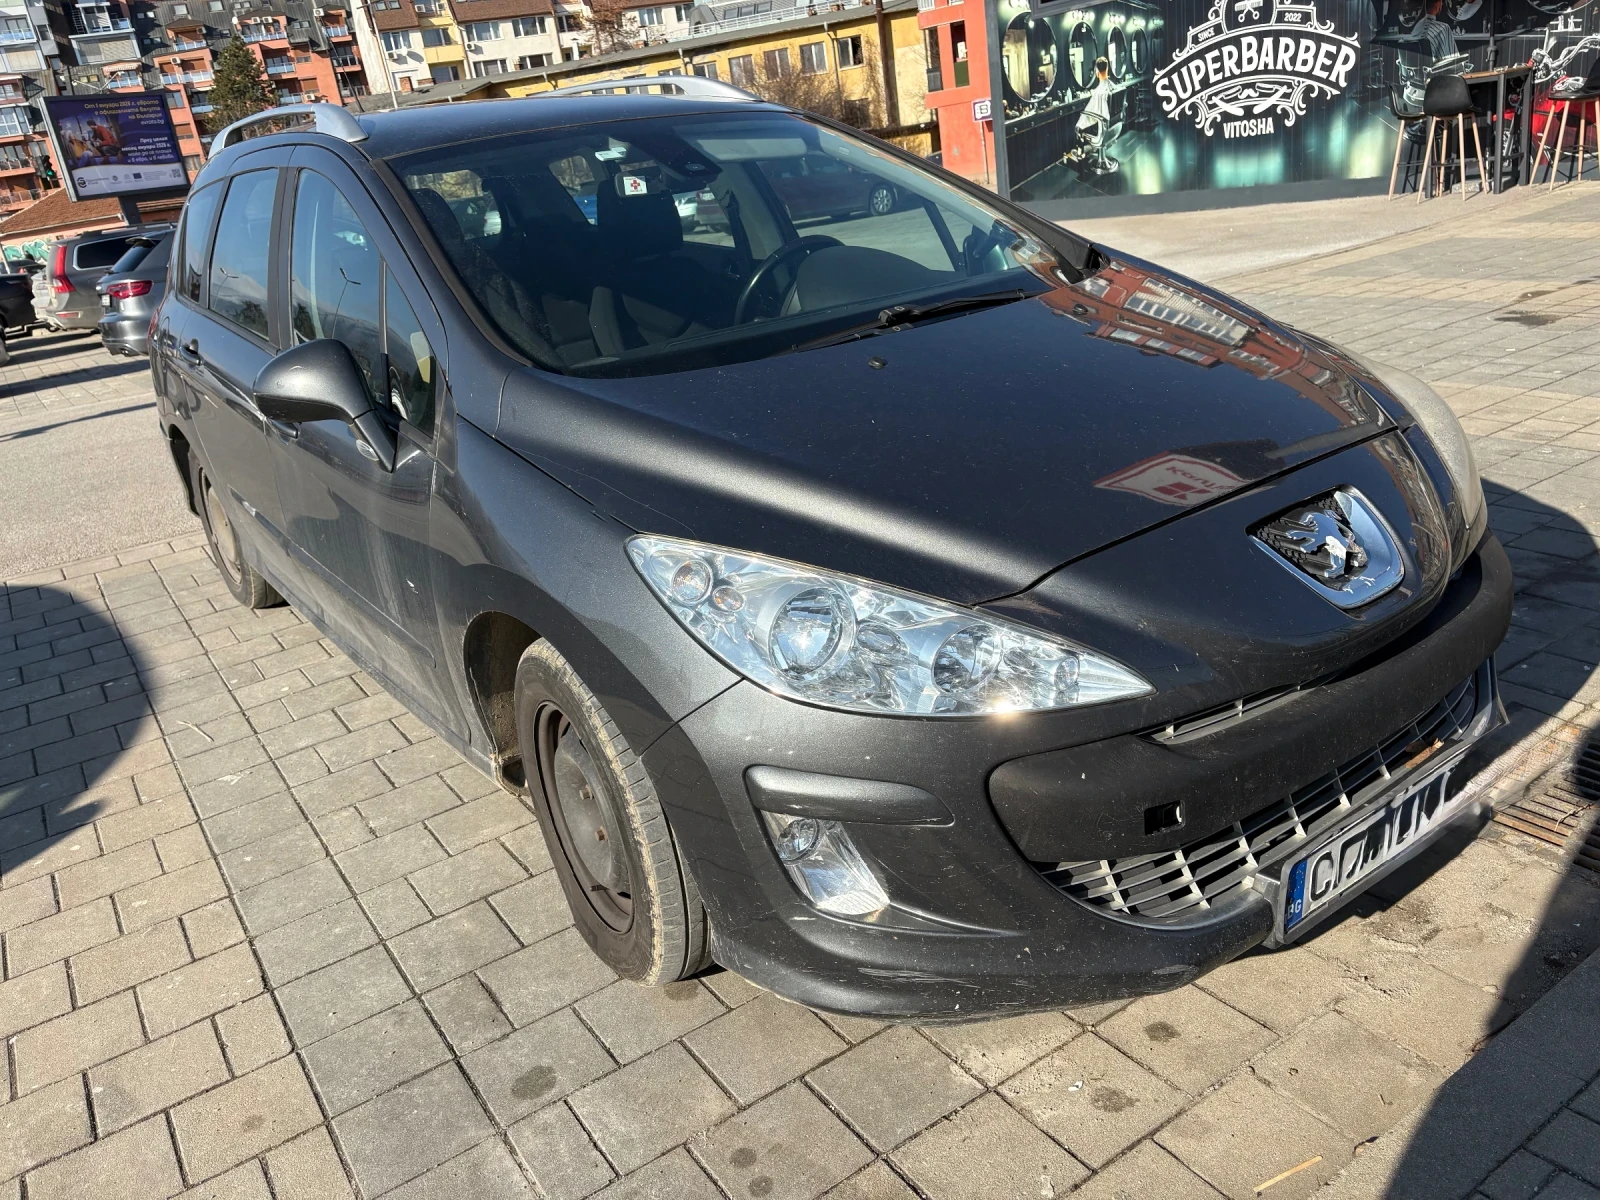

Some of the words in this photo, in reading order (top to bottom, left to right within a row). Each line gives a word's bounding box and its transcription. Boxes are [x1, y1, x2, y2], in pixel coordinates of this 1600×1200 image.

[1284, 12, 1302, 22] 2022
[1197, 27, 1215, 41] SINCE
[1155, 36, 1356, 111] SUPERBARBER
[1223, 116, 1275, 139] VITOSHA
[1287, 899, 1302, 918] BG
